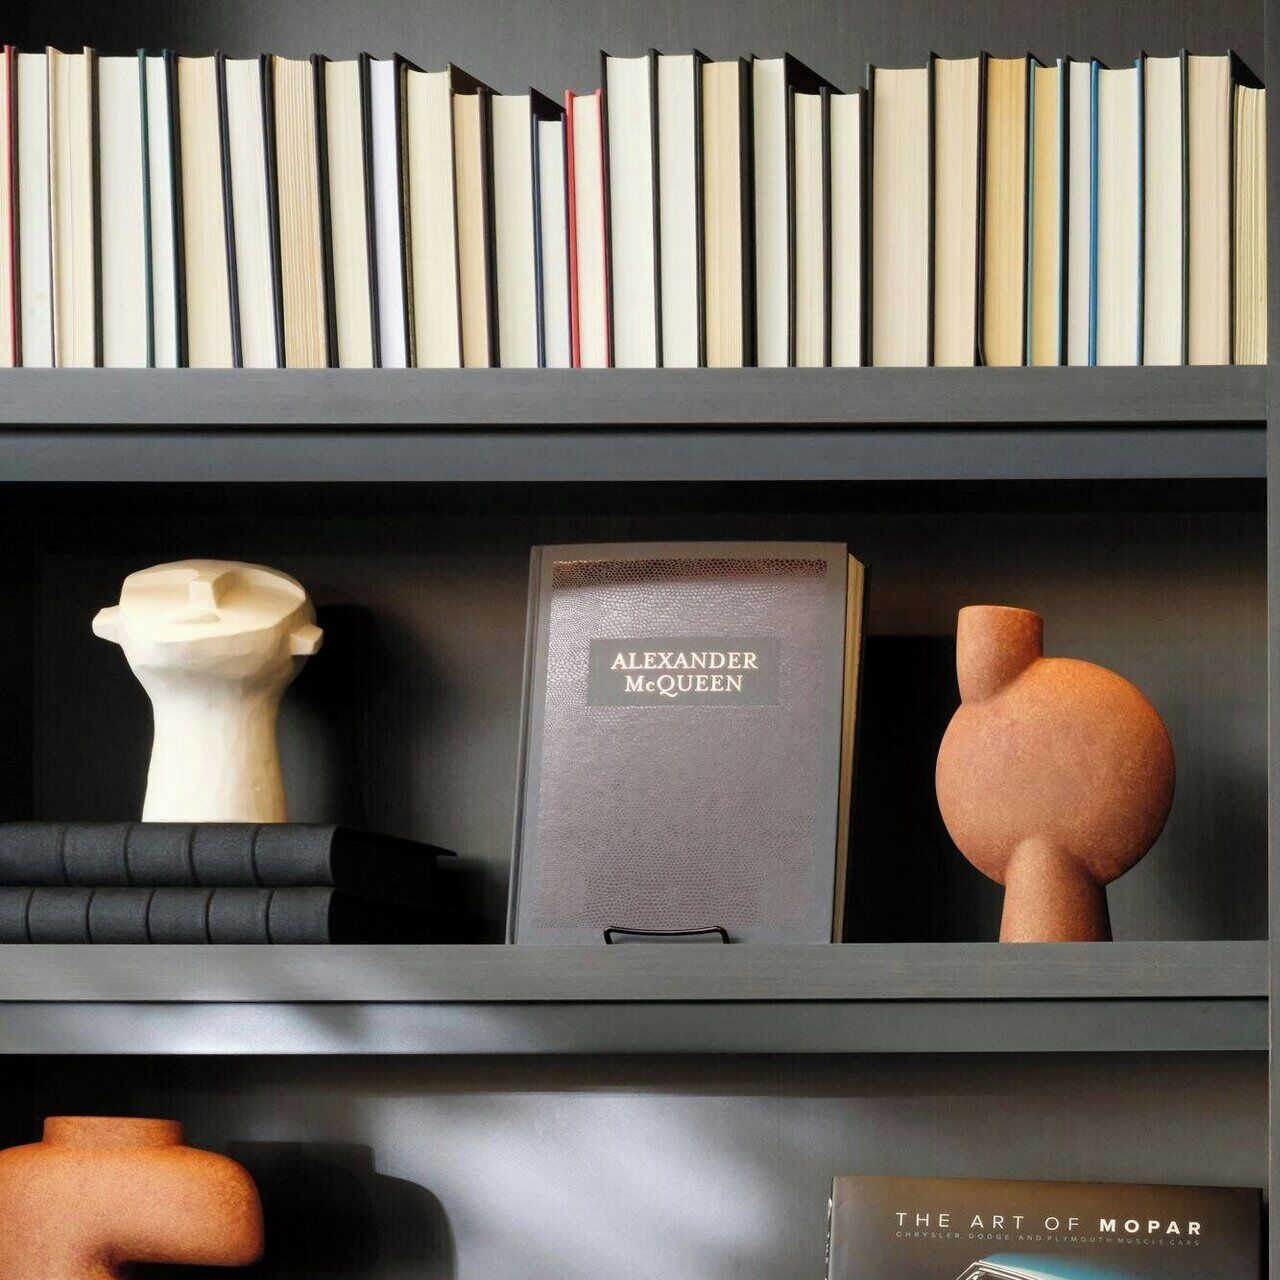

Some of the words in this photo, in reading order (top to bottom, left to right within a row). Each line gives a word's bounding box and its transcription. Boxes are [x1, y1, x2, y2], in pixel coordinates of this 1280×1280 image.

[611, 652, 758, 669] ALEXANDER
[624, 674, 743, 697] McQUEEN
[895, 1212, 950, 1228] THE
[970, 1214, 1025, 1230] ART
[1044, 1216, 1080, 1231] OF
[1099, 1218, 1201, 1236] MOPAR
[1047, 1235, 1113, 1244] PLYMOUTH
[1118, 1237, 1164, 1245] MUSCLE
[1169, 1239, 1200, 1247] CARS
